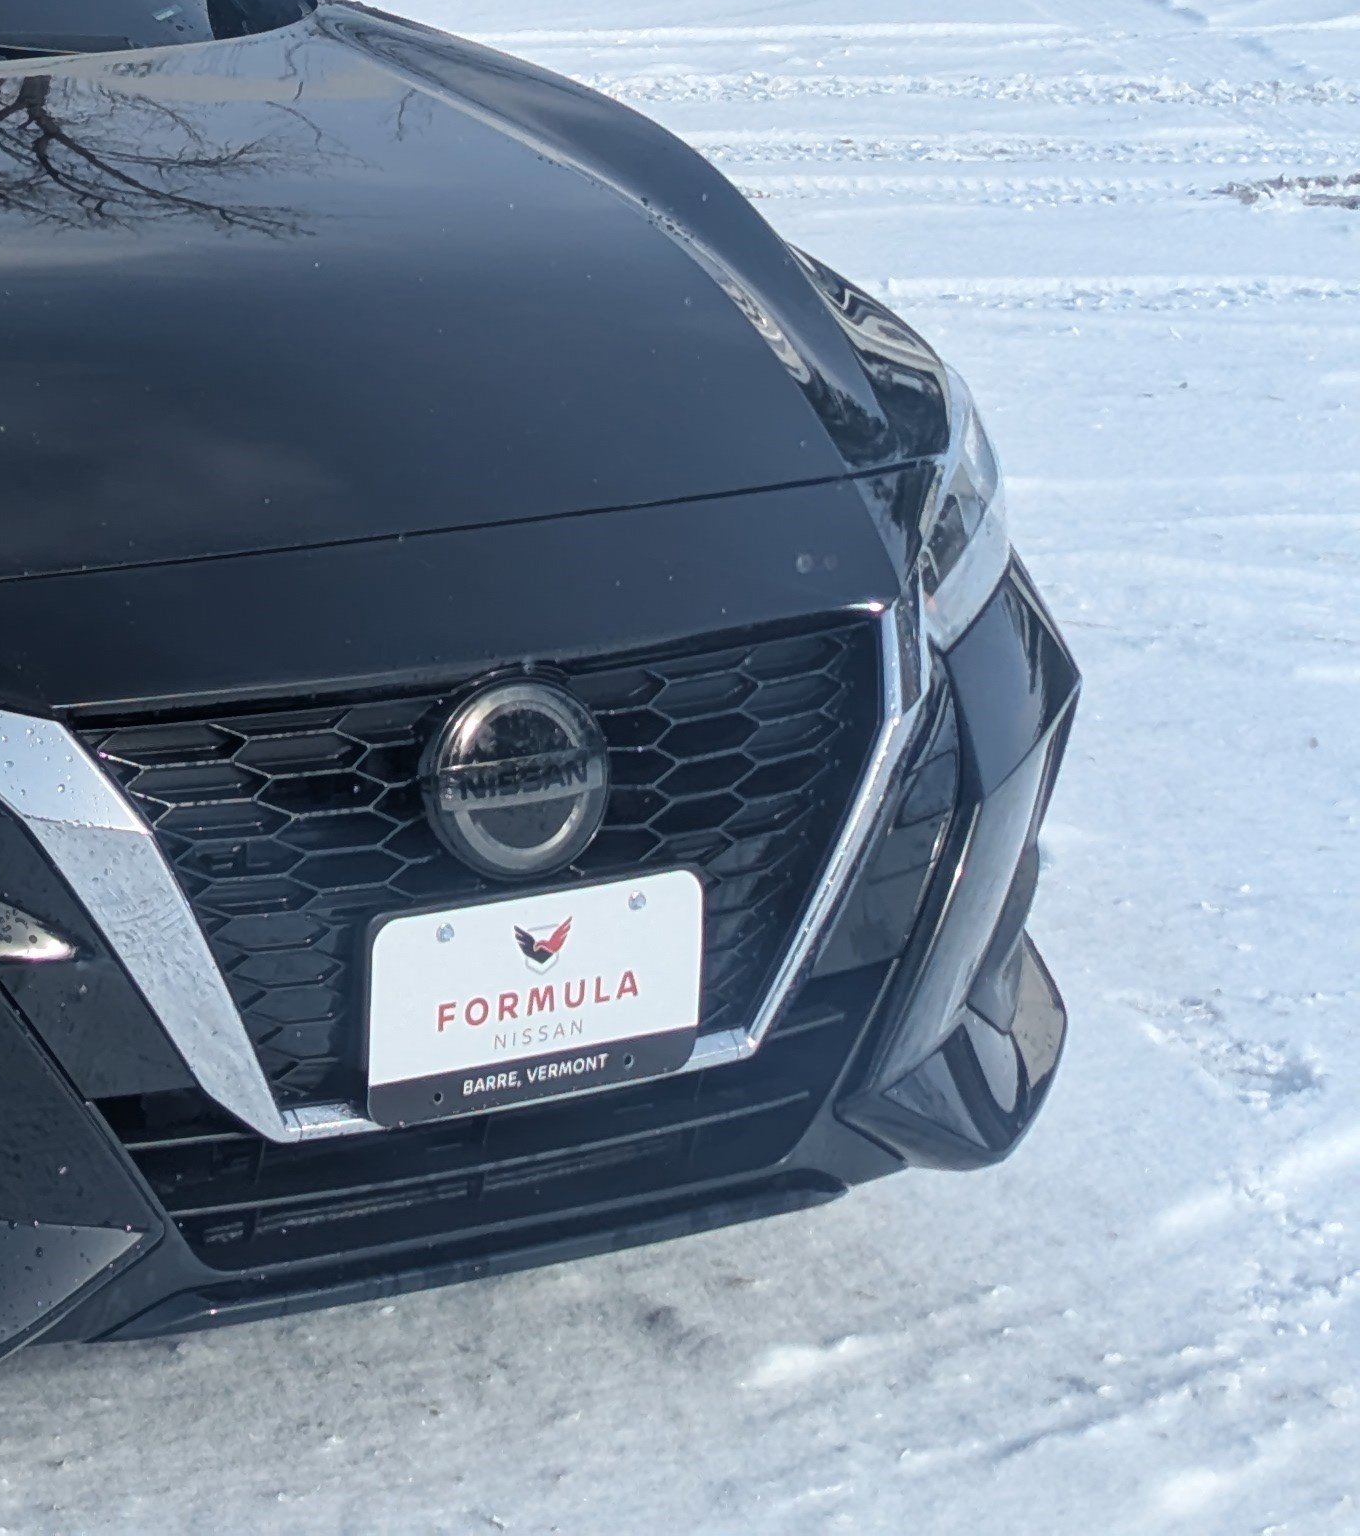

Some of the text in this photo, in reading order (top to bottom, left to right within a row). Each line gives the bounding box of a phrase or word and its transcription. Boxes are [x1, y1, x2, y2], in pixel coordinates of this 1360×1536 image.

[437, 969, 640, 1033] FORMULA
[493, 1018, 585, 1051] NISSAN
[462, 1052, 610, 1097] BARRE, VERMONT
